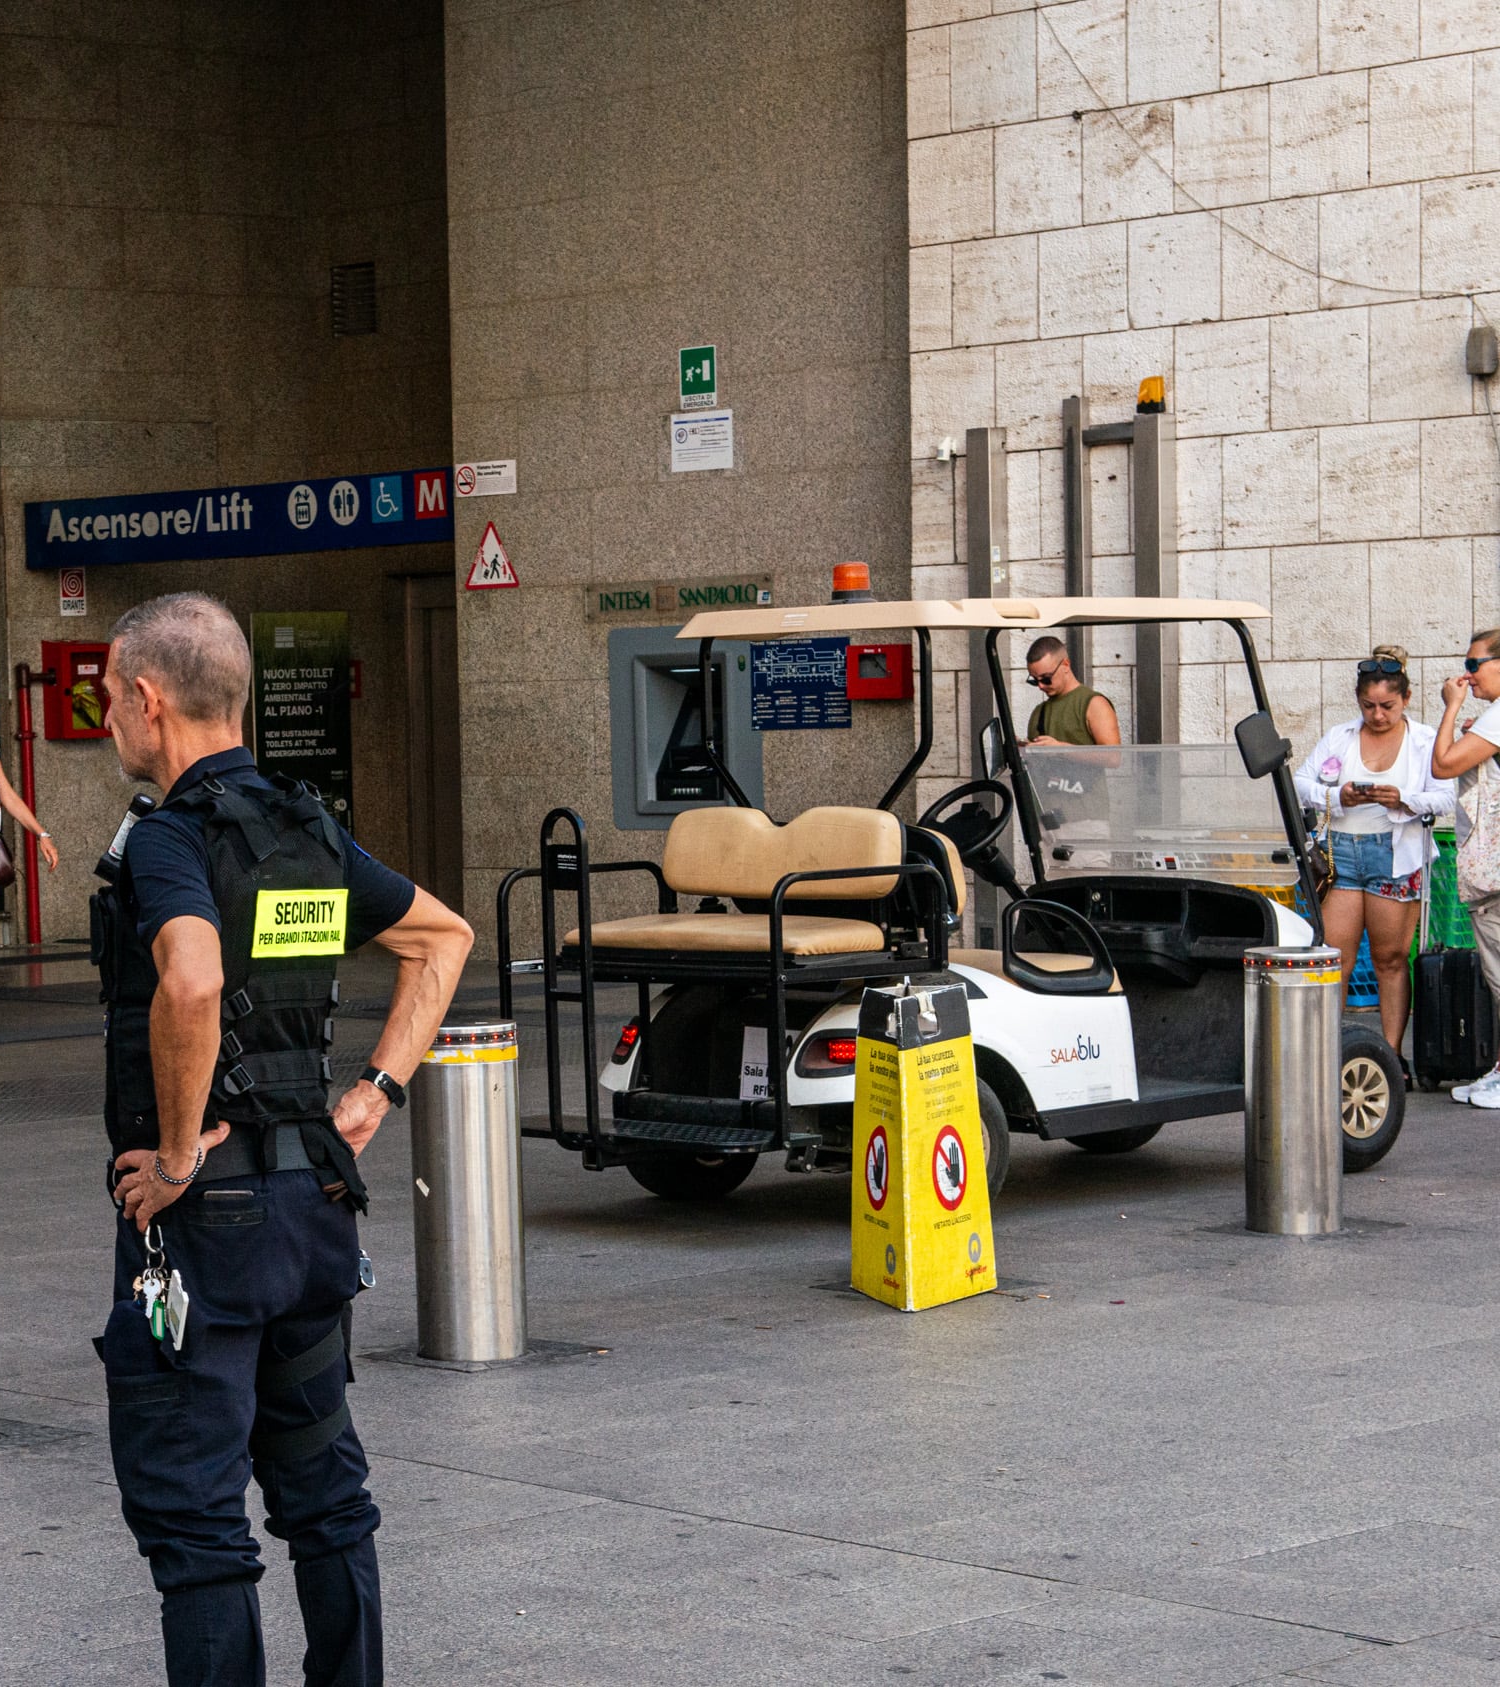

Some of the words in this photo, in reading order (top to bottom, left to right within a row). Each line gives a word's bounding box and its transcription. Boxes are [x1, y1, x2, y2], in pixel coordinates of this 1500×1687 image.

[684, 394, 705, 403] USCITA
[706, 393, 713, 401] DI
[683, 400, 714, 409] EMERGENZA
[46, 491, 254, 544] Ascensore/Lift
[599, 590, 651, 612] INTESA
[678, 583, 759, 608] SANPAOLO
[263, 668, 297, 680] NUOVE
[299, 667, 334, 679] TOILET
[263, 682, 270, 691] A
[271, 682, 292, 691] ZERO
[293, 681, 328, 690] IMPATTO
[264, 692, 313, 702] AMBIENTALE
[264, 706, 278, 716] AL
[280, 705, 313, 716] PIANO
[315, 705, 324, 715] -1
[265, 730, 280, 738] NEW
[281, 729, 326, 738] SUSTAINABLE
[265, 740, 293, 748] TOILETS
[294, 739, 303, 747] AT
[305, 739, 317, 747] THE
[265, 749, 315, 758] UNDERGROUND
[315, 747, 337, 756] FLOOR
[1047, 778, 1084, 794] FILA
[274, 900, 335, 925] SECURITY
[258, 932, 274, 945] PER
[275, 931, 300, 945] GRANDI
[300, 930, 329, 943] STAZIONI
[744, 1065, 764, 1078] Sala
[933, 1218, 951, 1230] VIETATO
